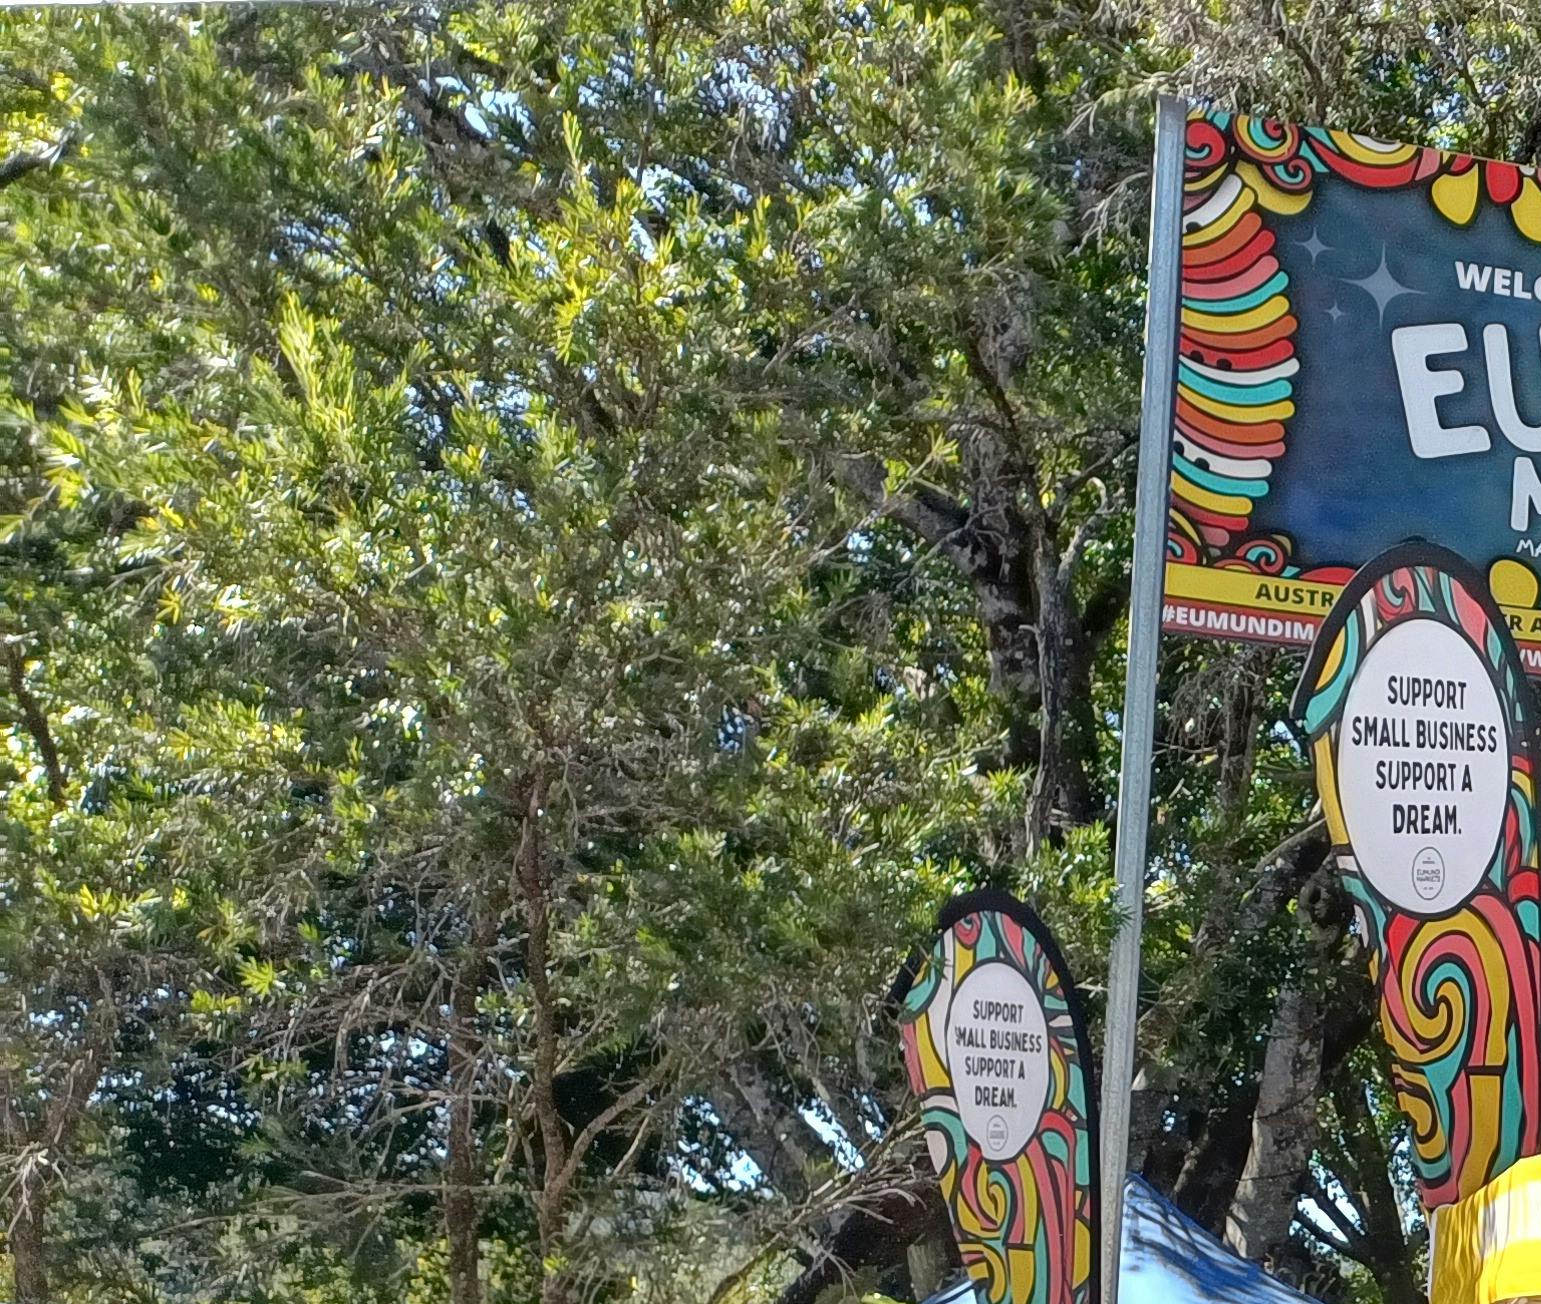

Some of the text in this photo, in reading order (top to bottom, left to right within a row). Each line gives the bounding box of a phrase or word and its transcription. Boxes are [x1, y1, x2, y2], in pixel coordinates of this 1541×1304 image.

[1255, 582, 1334, 608] AUSTR
[1162, 604, 1315, 641] #EUMUNDIM
[1387, 676, 1467, 710] SUPPORT
[1352, 716, 1497, 753] SMALL BUSINESS
[1375, 760, 1473, 792] SUPPORT A
[1393, 804, 1462, 835] DREAM.
[973, 1000, 1023, 1024] SUPPORT
[955, 1025, 1042, 1053] SMALL BUSINESS
[965, 1056, 1026, 1080] SUPPORT A
[975, 1086, 1017, 1109] DREAM.
